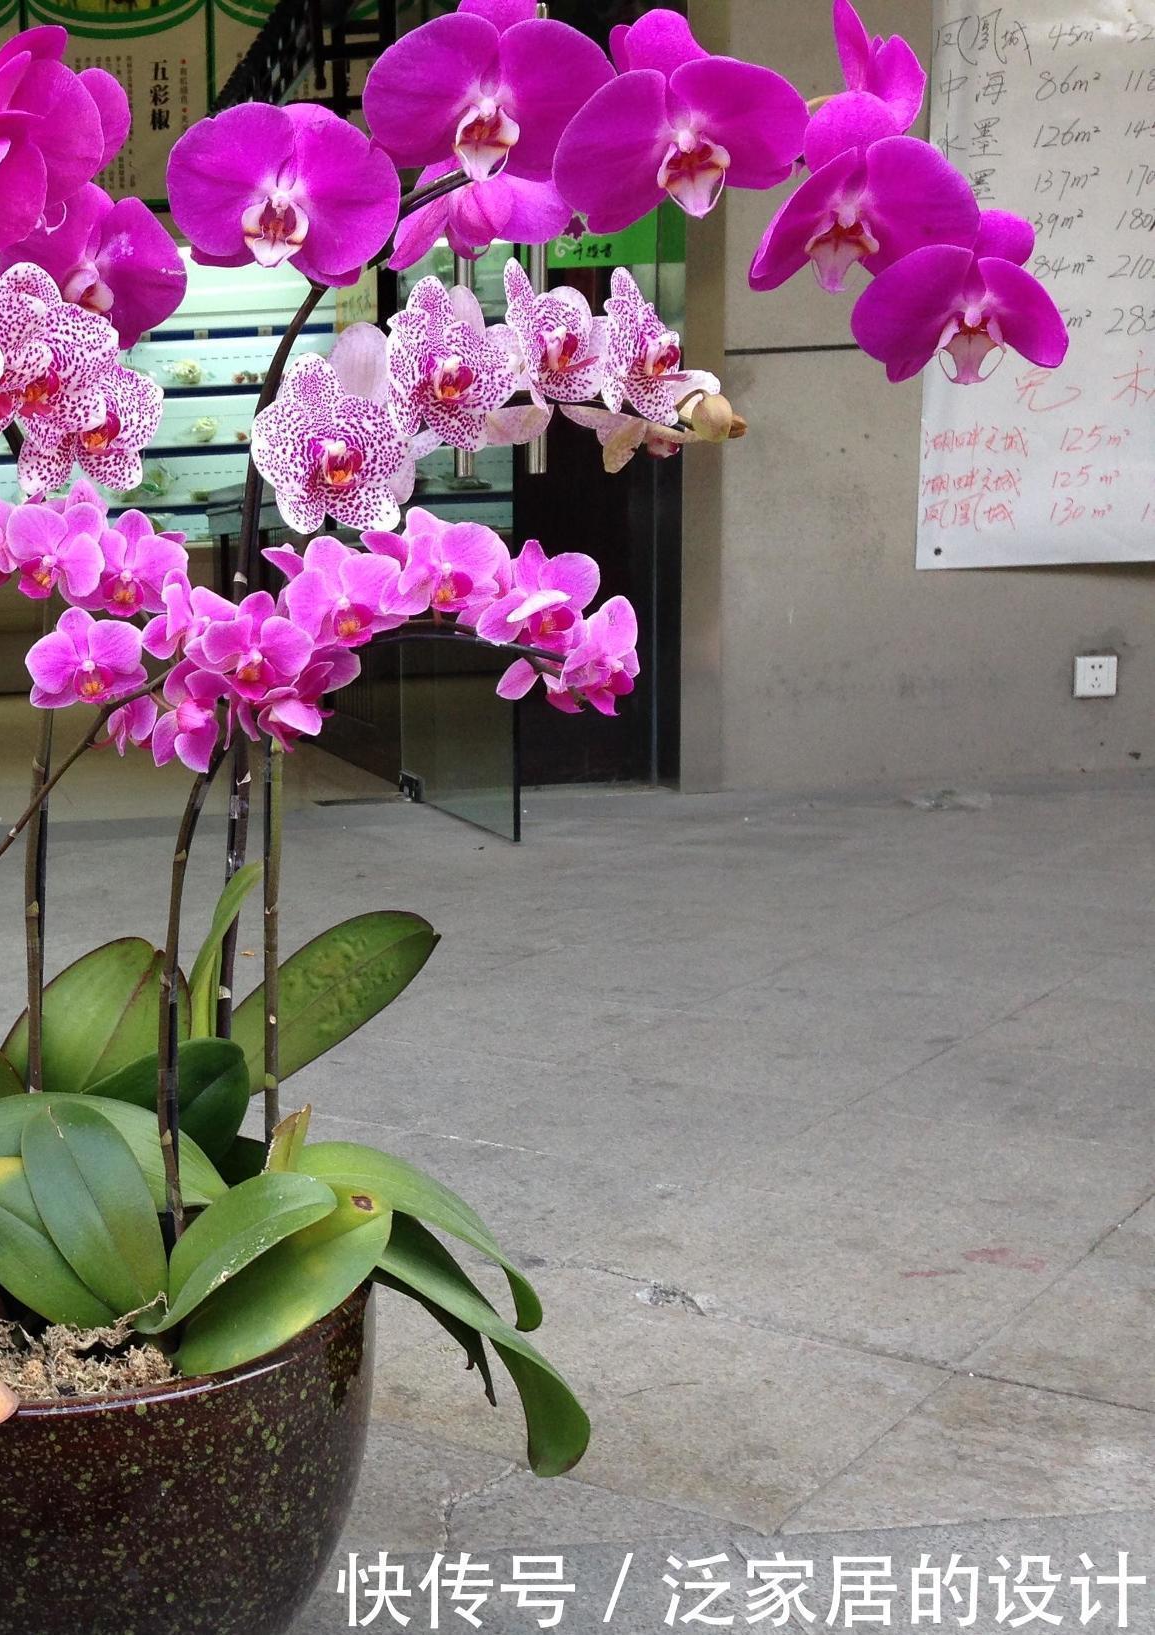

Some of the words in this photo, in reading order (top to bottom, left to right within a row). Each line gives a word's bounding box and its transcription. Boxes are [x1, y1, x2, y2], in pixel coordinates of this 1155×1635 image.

[150, 60, 170, 130] 五彩椒
[939, 68, 1007, 108] 中海
